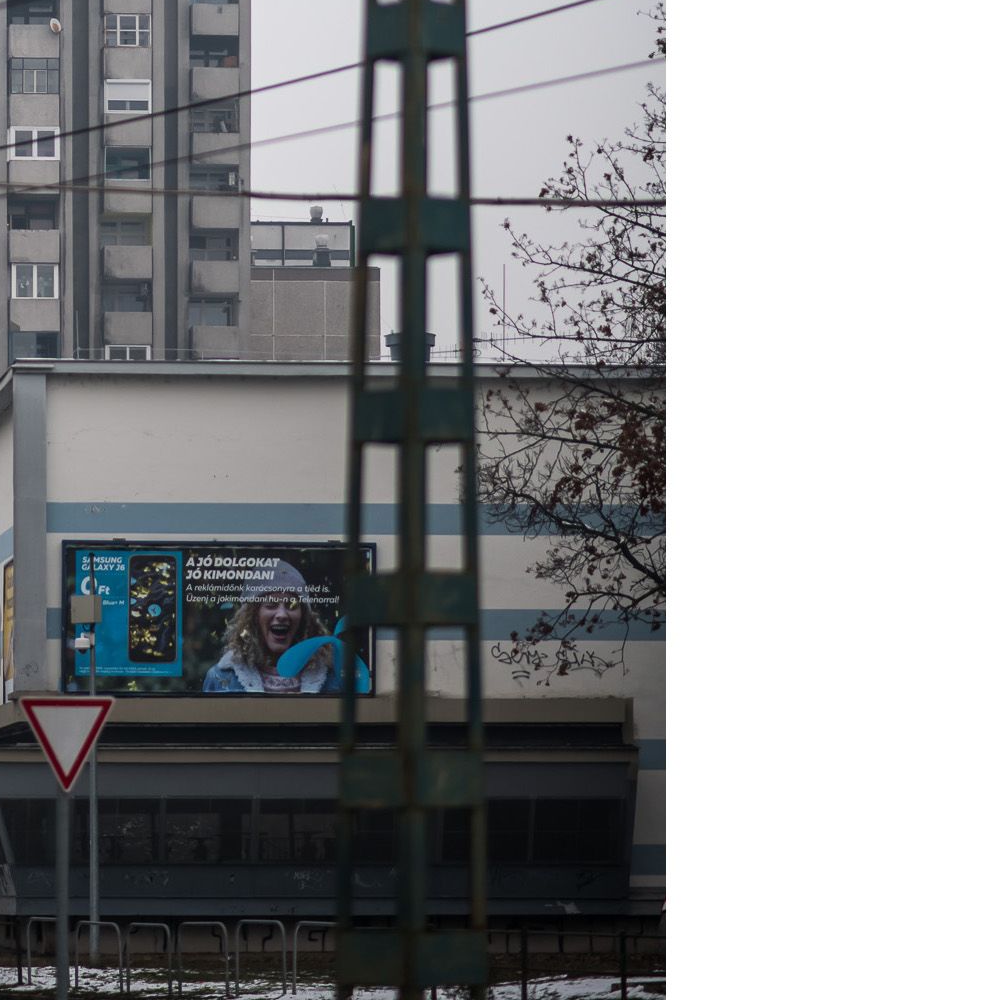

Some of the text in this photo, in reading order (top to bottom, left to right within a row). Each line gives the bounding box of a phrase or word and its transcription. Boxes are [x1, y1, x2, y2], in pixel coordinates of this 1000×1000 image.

[186, 554, 280, 568] A JÓ DOLGOKAT
[115, 563, 126, 571] J6
[185, 567, 275, 580] JÓ KIMONDANI
[98, 585, 110, 595] Ft
[186, 583, 193, 591] A
[194, 583, 244, 592] reklámidőnk
[246, 584, 296, 594] karácsonyra
[322, 585, 331, 593] is.
[186, 593, 209, 604] Üzenj
